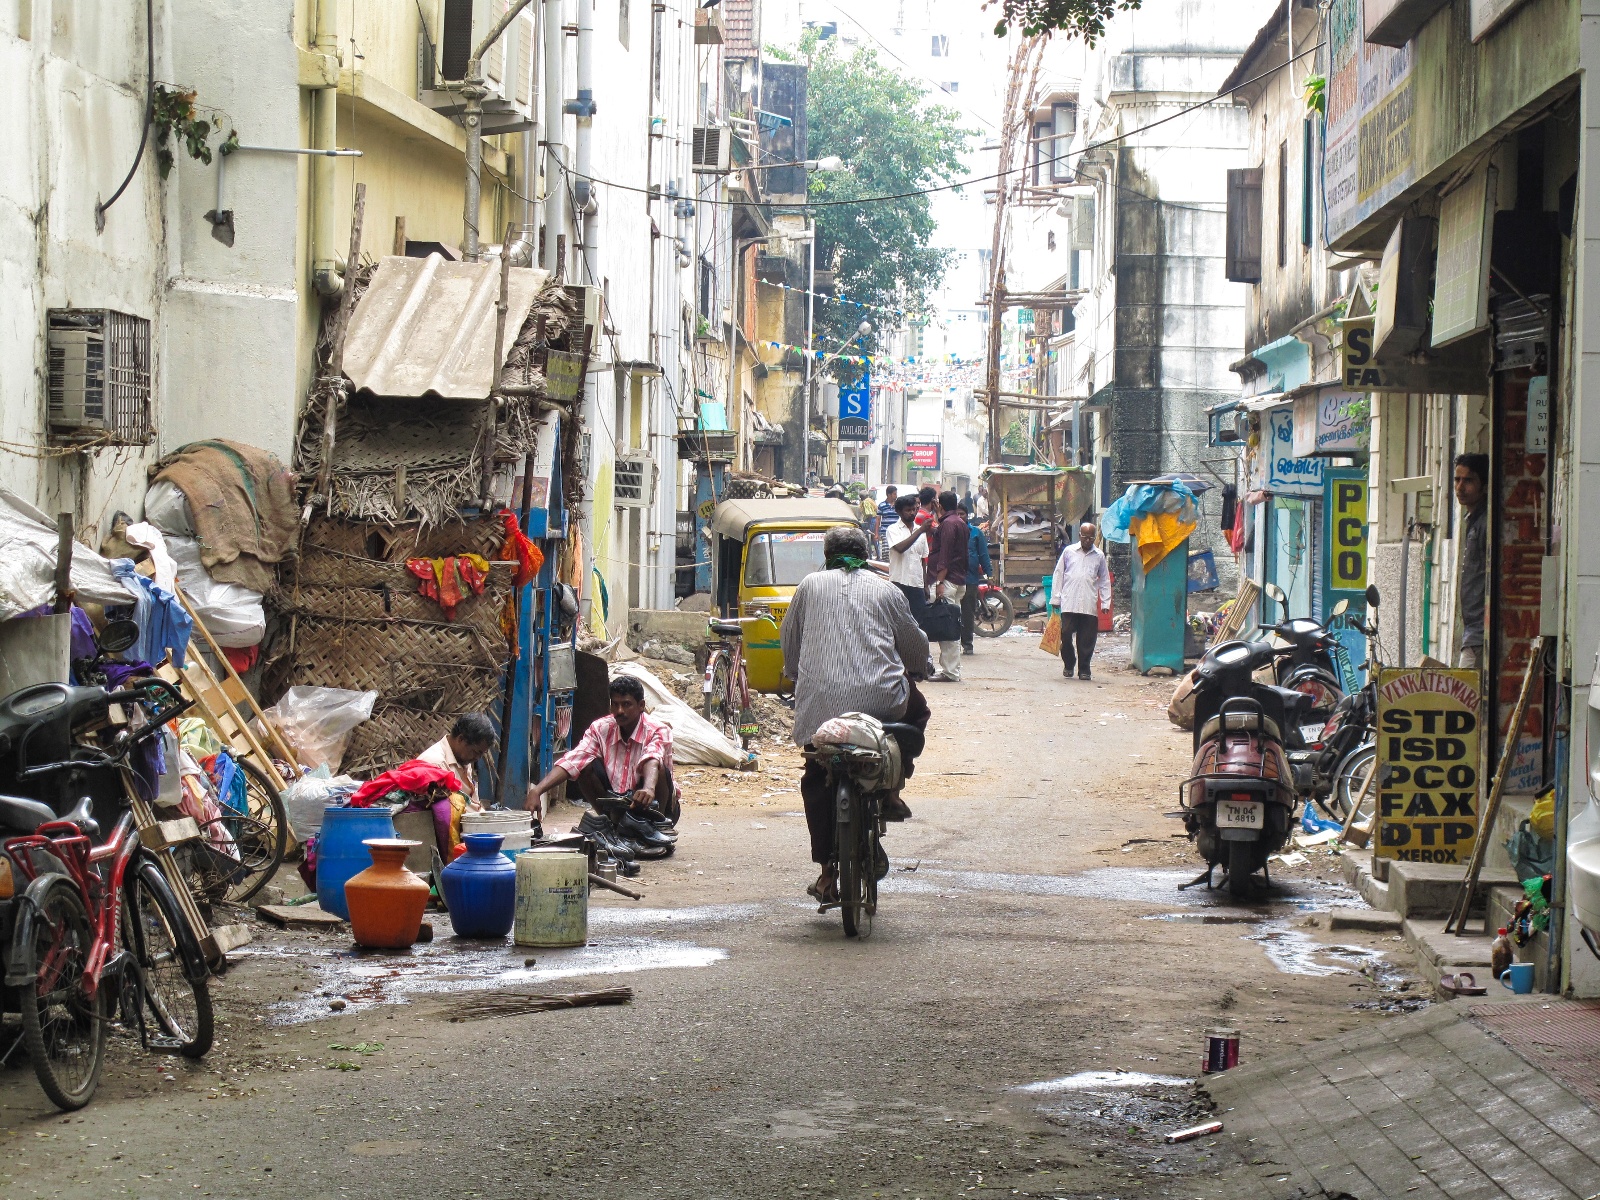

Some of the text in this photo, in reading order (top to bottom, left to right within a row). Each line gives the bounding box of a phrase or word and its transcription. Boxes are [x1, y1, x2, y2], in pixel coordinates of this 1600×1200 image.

[840, 425, 868, 436] AVAILABLE
[1338, 483, 1362, 580] PCO
[1380, 673, 1480, 712] VENKATESWARA
[1382, 708, 1476, 735] STD
[1388, 736, 1467, 762] ISD
[1380, 764, 1476, 789] PCO
[1229, 806, 1254, 815] TN 04
[1381, 792, 1476, 817] FAX
[1227, 814, 1256, 822] L 4819
[1380, 822, 1475, 847] DTP
[1397, 848, 1458, 864] XEROX
